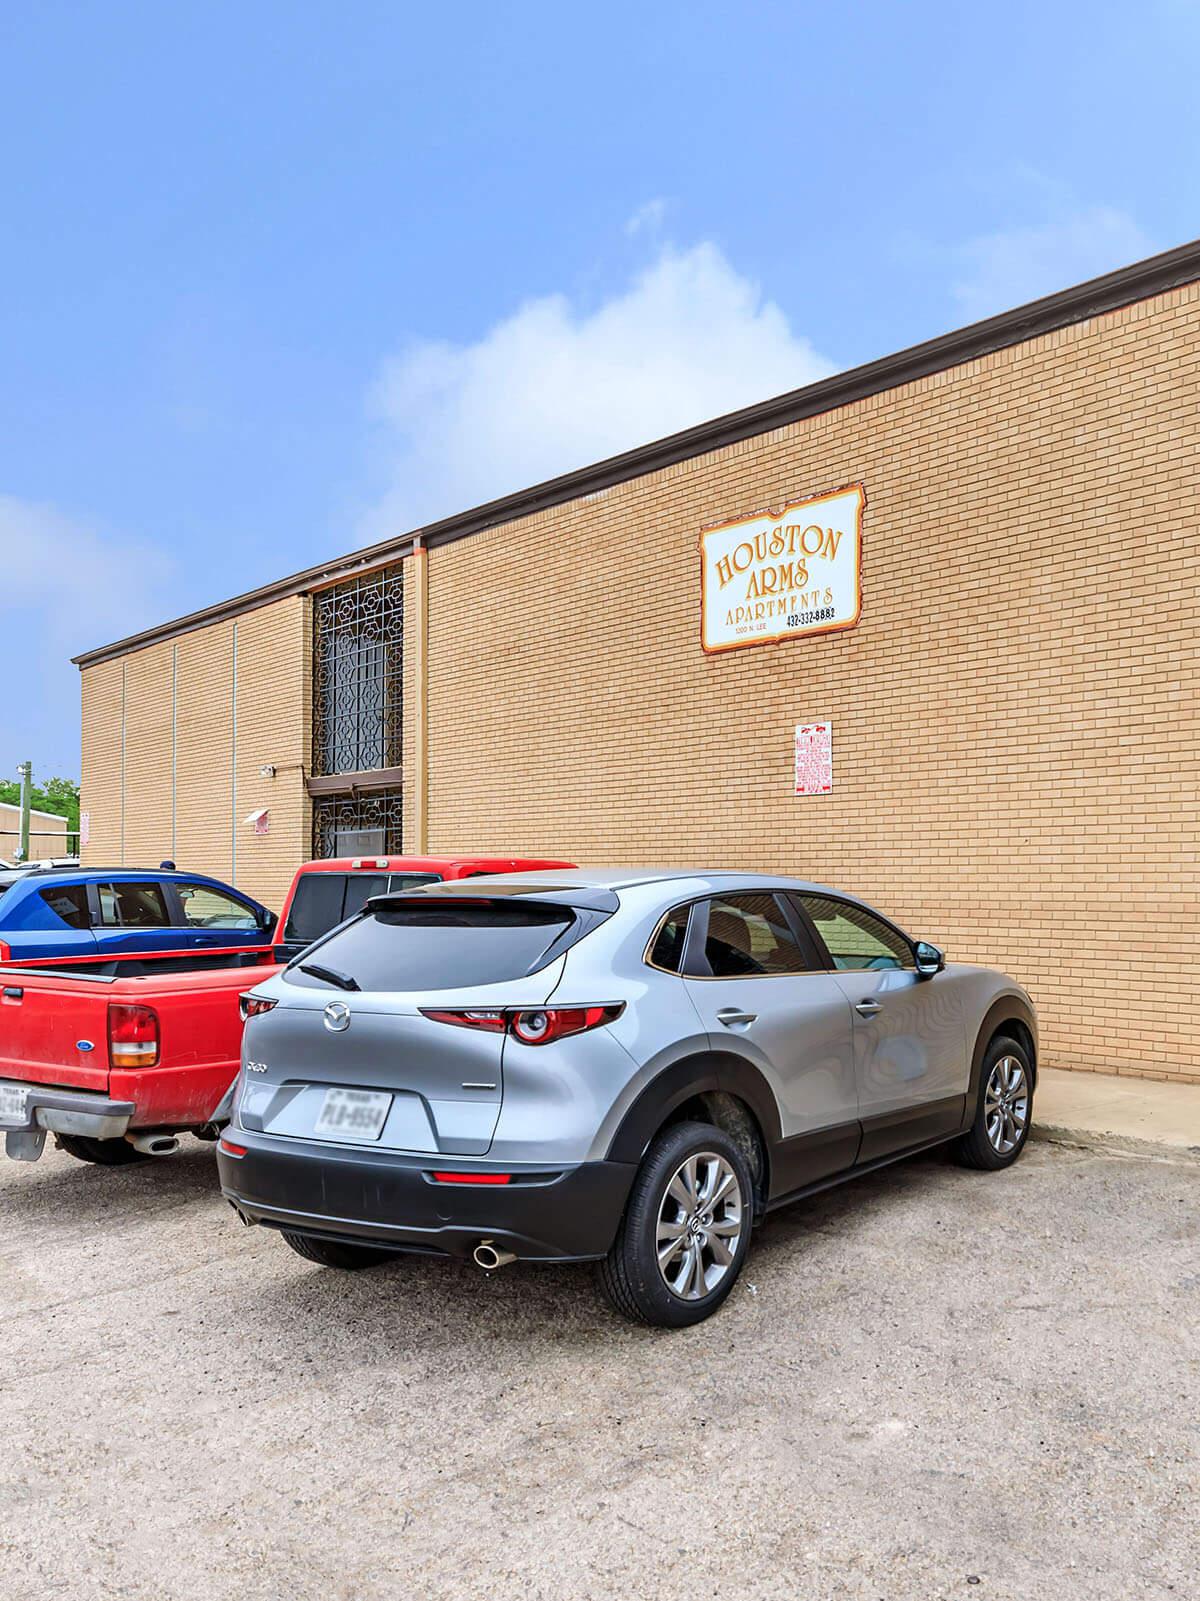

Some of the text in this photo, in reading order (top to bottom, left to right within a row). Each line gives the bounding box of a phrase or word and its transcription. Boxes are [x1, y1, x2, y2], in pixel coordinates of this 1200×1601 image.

[715, 524, 843, 588] HOUSTON
[745, 558, 809, 600] ARMS
[726, 587, 833, 625] APARTMENTS
